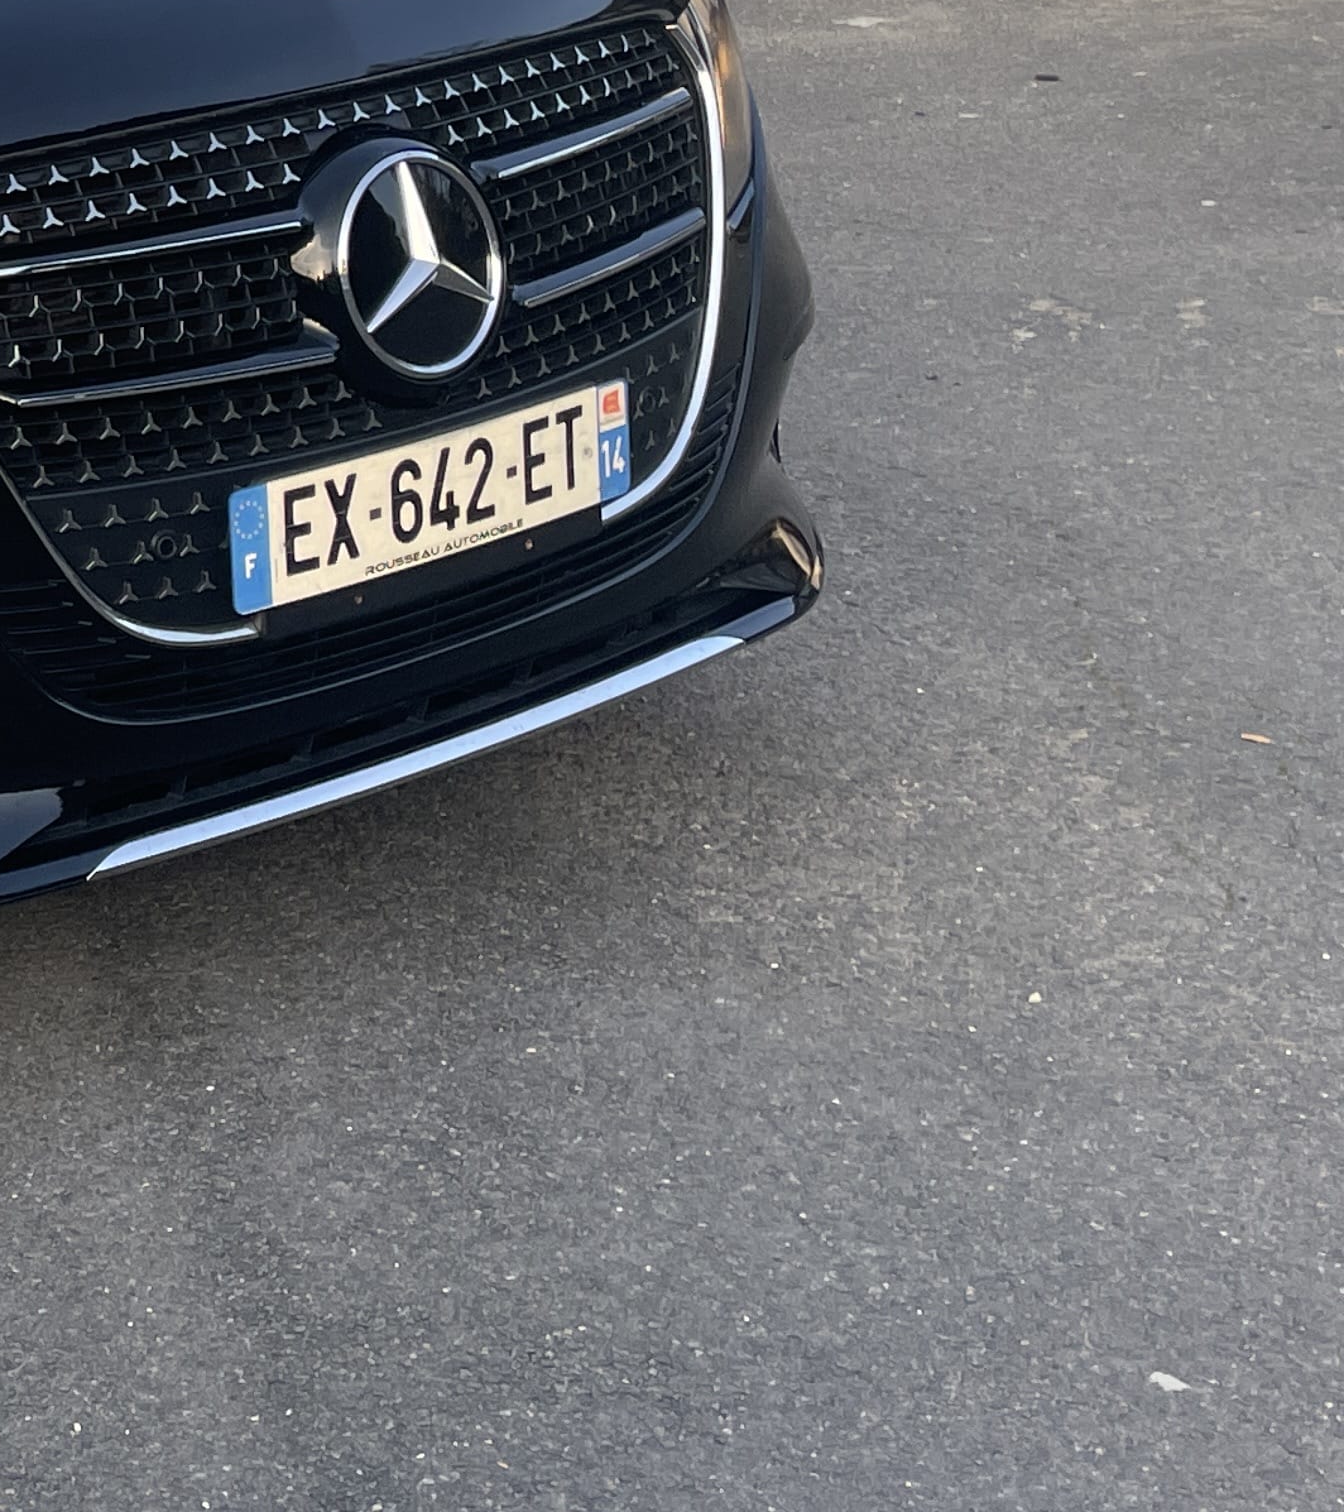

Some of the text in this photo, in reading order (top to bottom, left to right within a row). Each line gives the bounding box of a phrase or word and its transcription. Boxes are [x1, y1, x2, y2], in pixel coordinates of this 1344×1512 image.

[600, 434, 626, 479] 14
[283, 405, 584, 577] EX-642-ET
[243, 552, 258, 580] F
[364, 518, 524, 576] ROUSSEAU AUTOMOBILE
